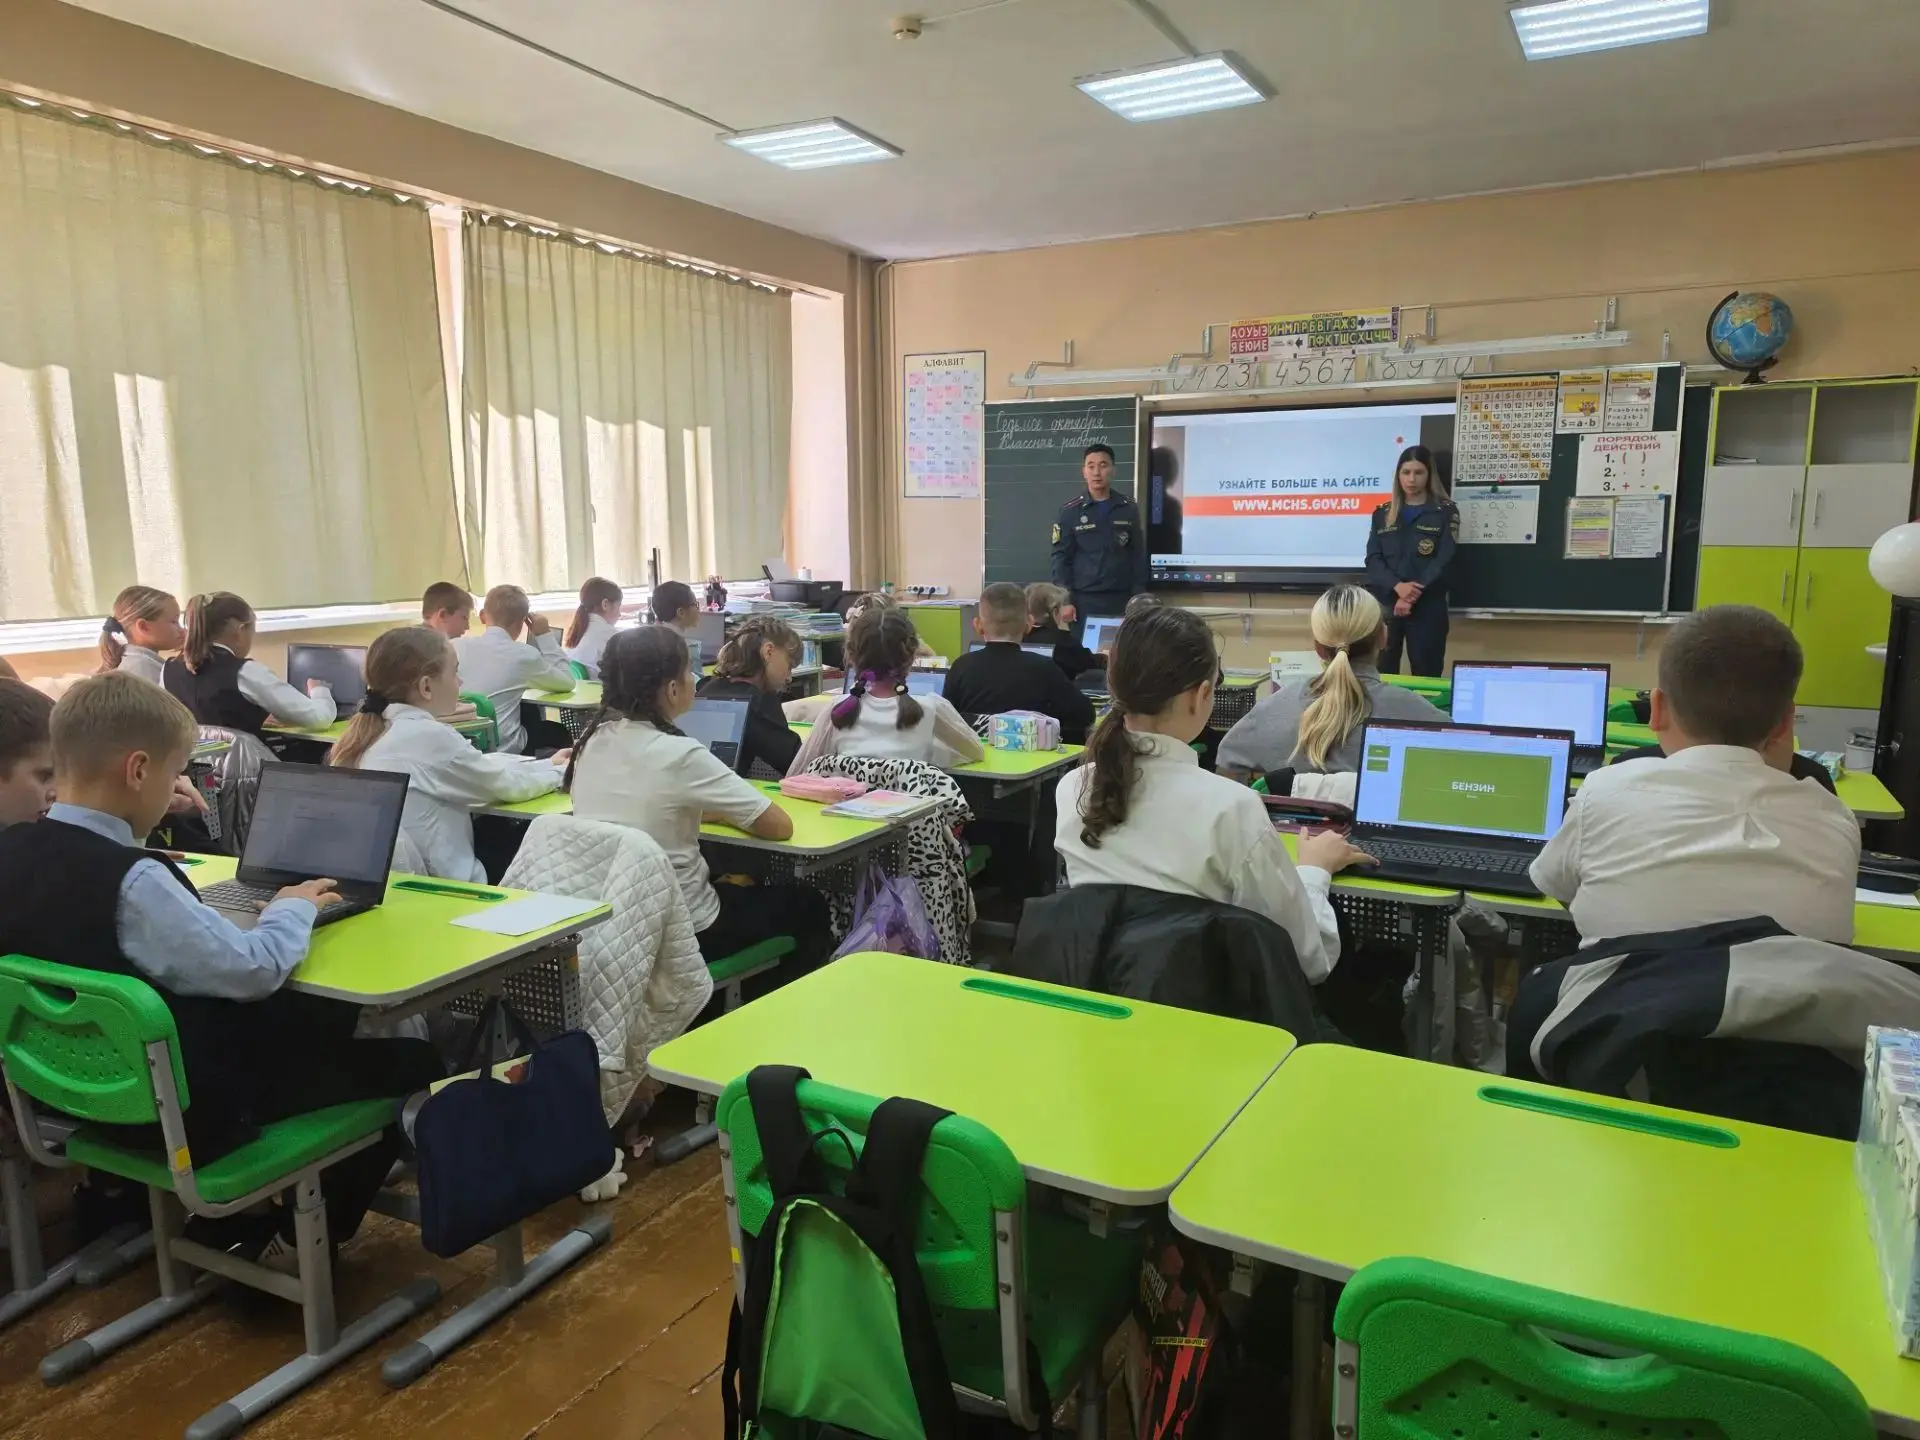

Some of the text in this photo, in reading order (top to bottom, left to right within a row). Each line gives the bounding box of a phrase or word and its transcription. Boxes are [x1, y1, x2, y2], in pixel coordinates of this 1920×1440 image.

[924, 358, 966, 368] АЛФАВИТ
[1605, 453, 1615, 463] 1.
[1604, 467, 1616, 477] 2.
[1219, 476, 1380, 489] УЗНАЙТЕ БОЛЬШЕ НА САЙТЕ
[1603, 482, 1615, 491] 3.
[1232, 498, 1360, 511] WWW.MCHS.GOV.RU
[1451, 781, 1496, 793] БЕНЗИН
